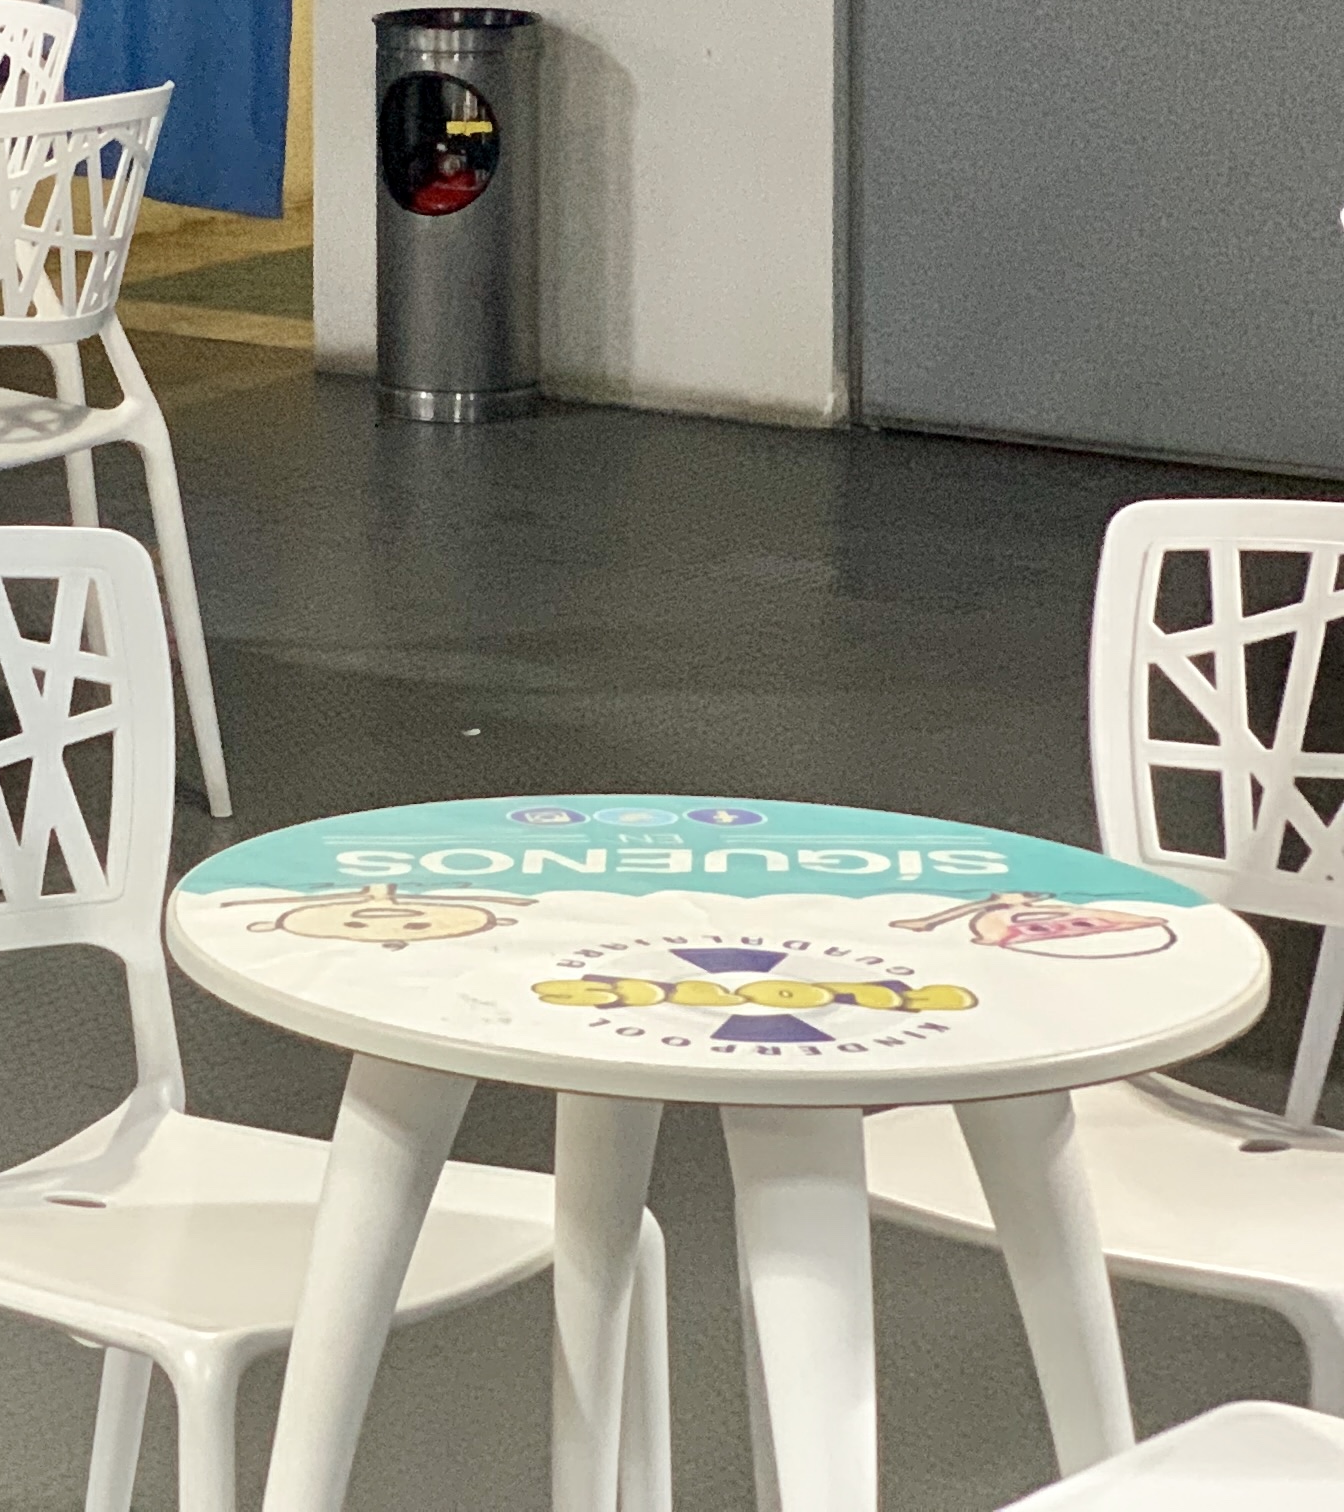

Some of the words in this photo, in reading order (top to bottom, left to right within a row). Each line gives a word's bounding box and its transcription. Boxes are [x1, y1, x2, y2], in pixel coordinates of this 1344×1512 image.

[335, 848, 1010, 881] SÍGUENOS
[556, 935, 915, 977] GUADALAJARA
[531, 979, 979, 1012] FLOTIS
[588, 1016, 951, 1057] KINDERPOOL
